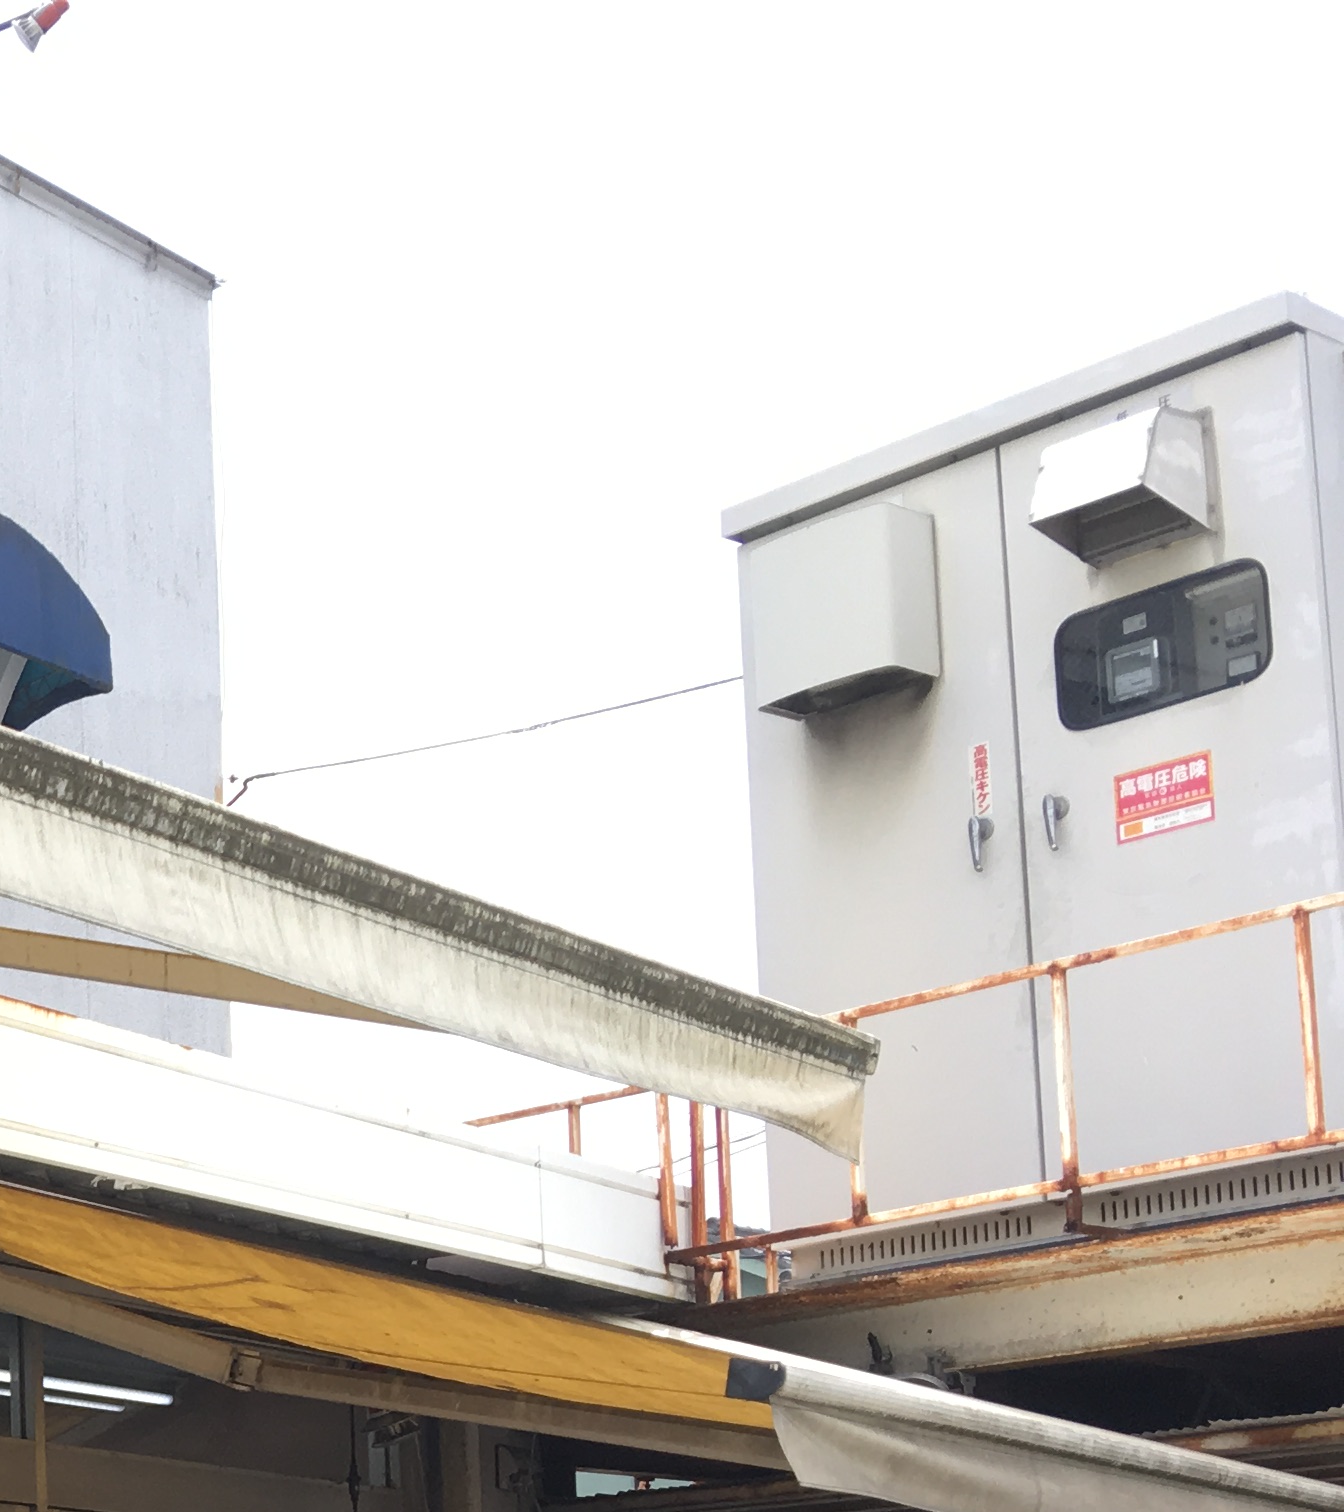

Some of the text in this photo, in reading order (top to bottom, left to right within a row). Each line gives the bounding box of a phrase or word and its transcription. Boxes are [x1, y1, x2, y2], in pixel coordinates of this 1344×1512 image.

[1118, 759, 1207, 799] 高電圧危険
